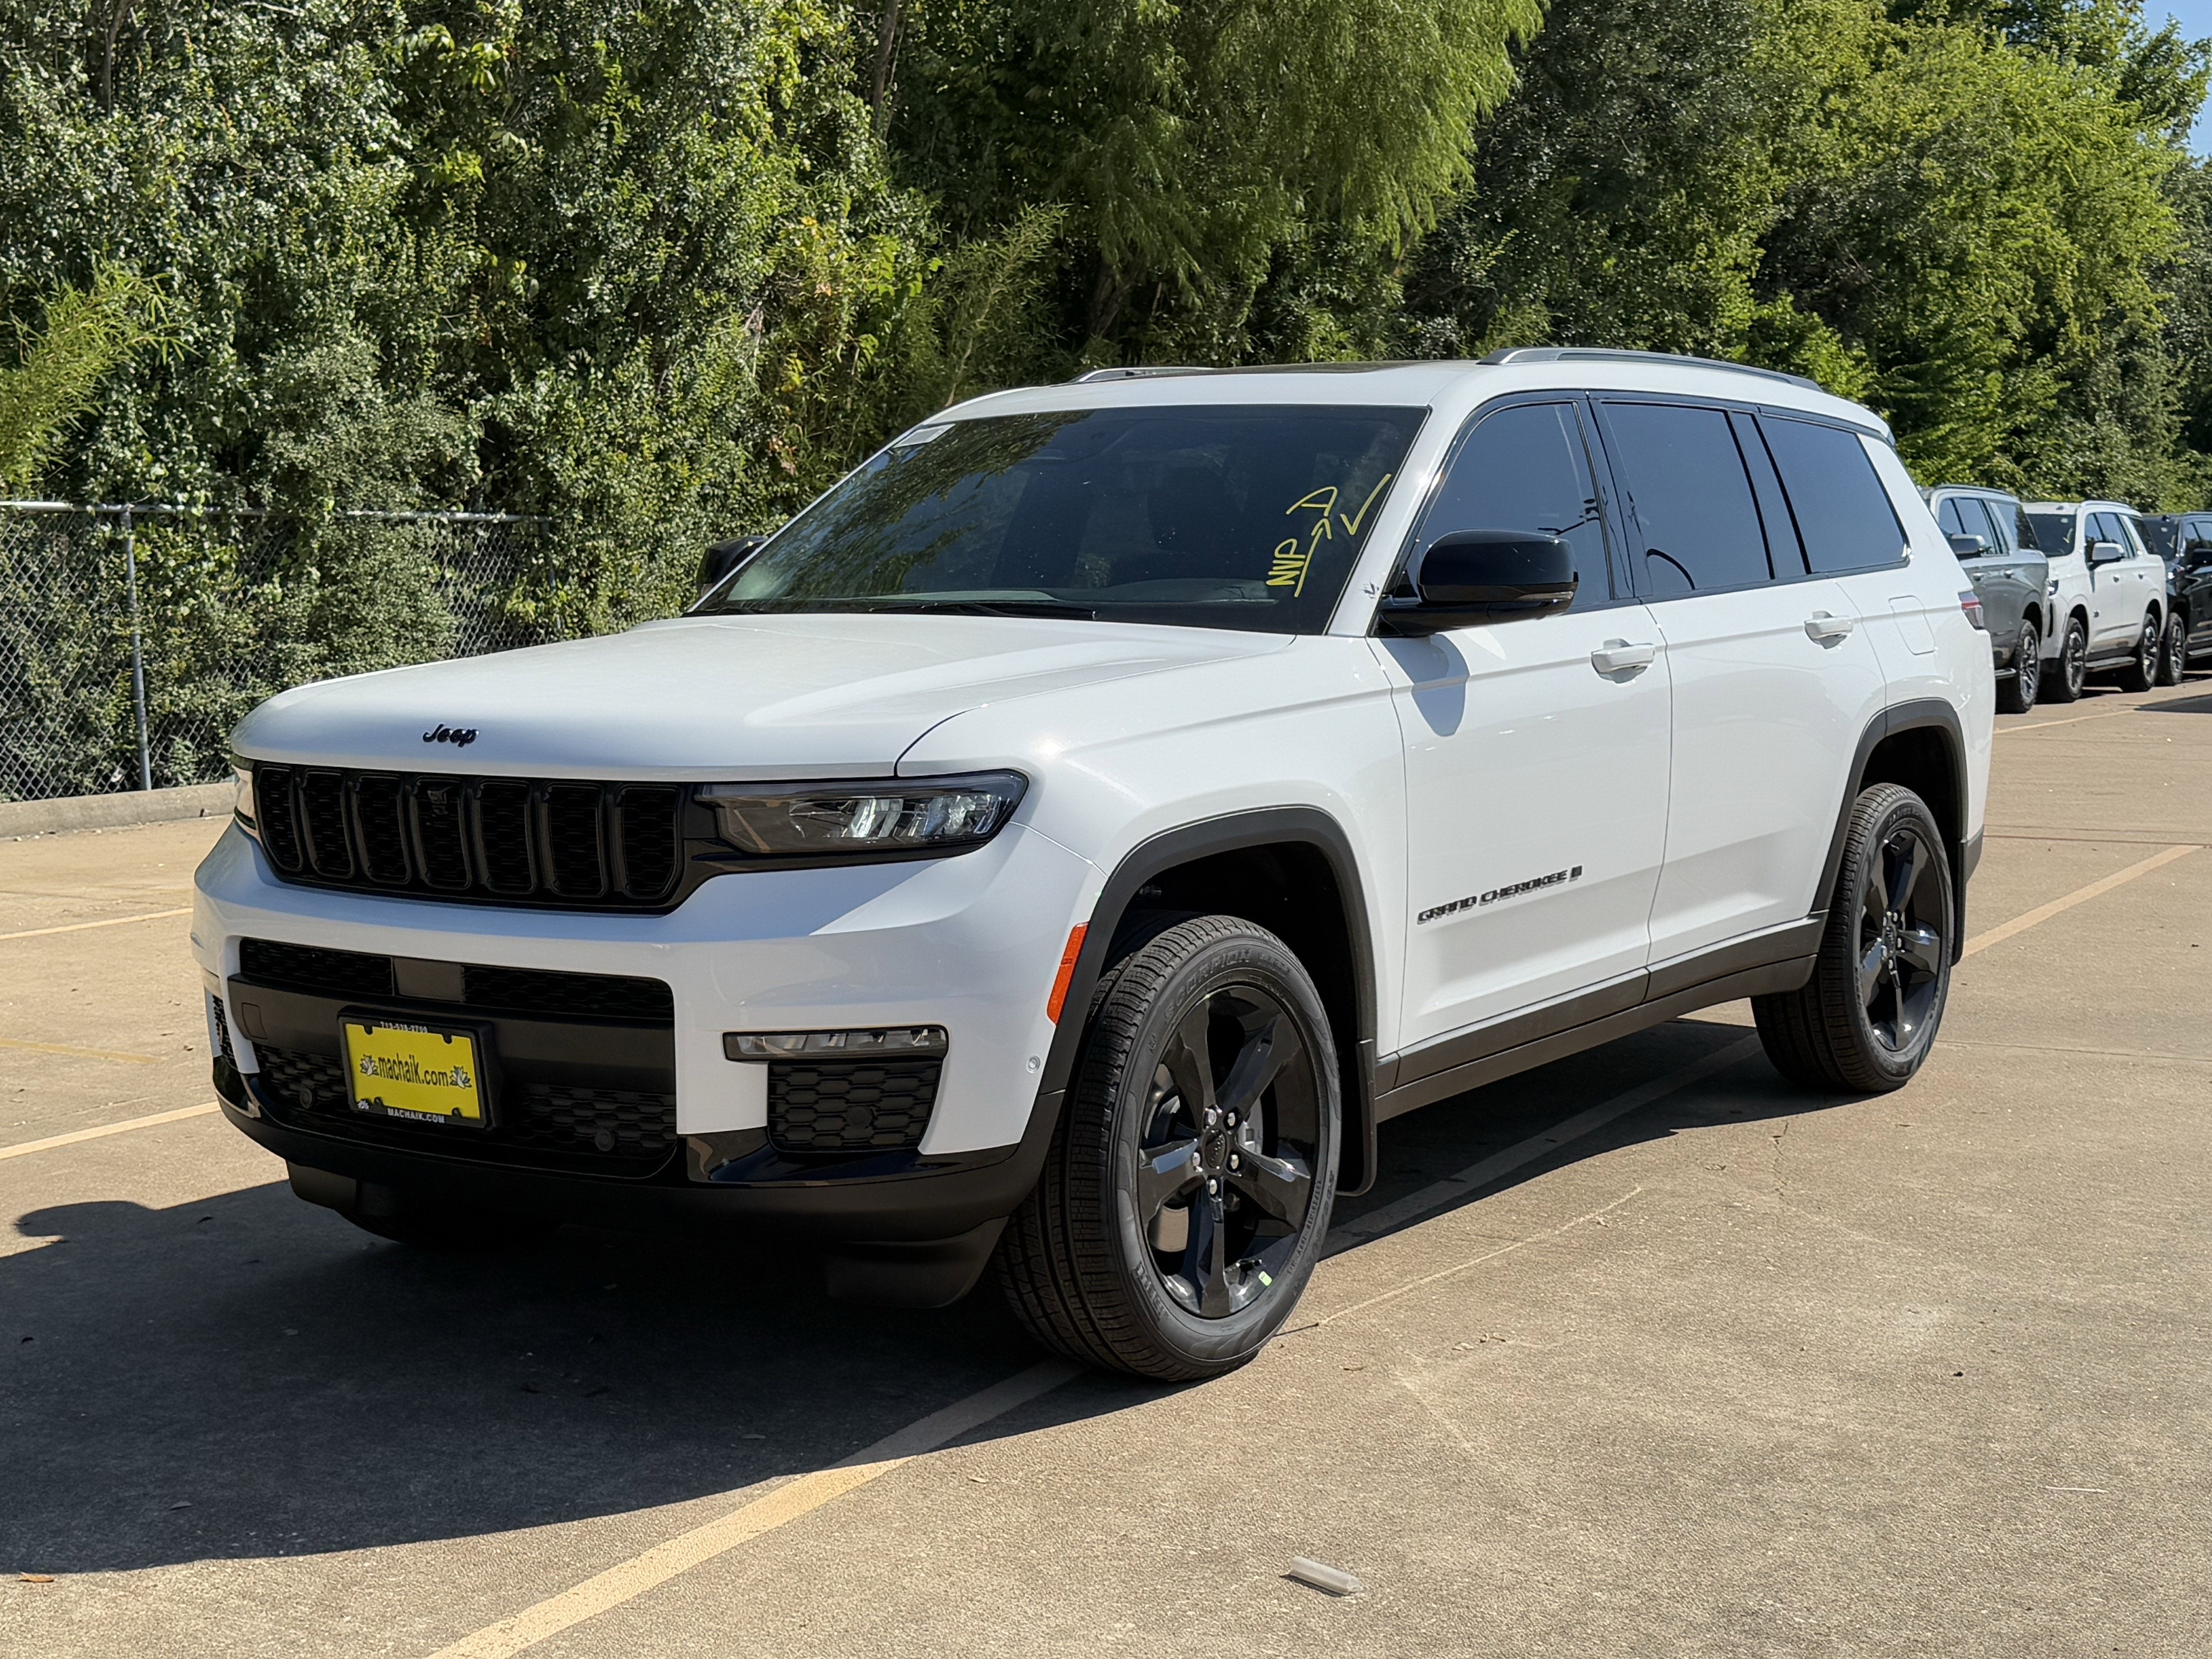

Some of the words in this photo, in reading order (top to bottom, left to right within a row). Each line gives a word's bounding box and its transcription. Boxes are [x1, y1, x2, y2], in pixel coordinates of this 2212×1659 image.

[422, 724, 479, 747] Jeep
[1418, 896, 1477, 921] GRAND
[1480, 870, 1568, 902] CHEROKEE
[378, 1053, 448, 1087] machaik.com
[388, 1108, 445, 1123] MACHAIK.COM
